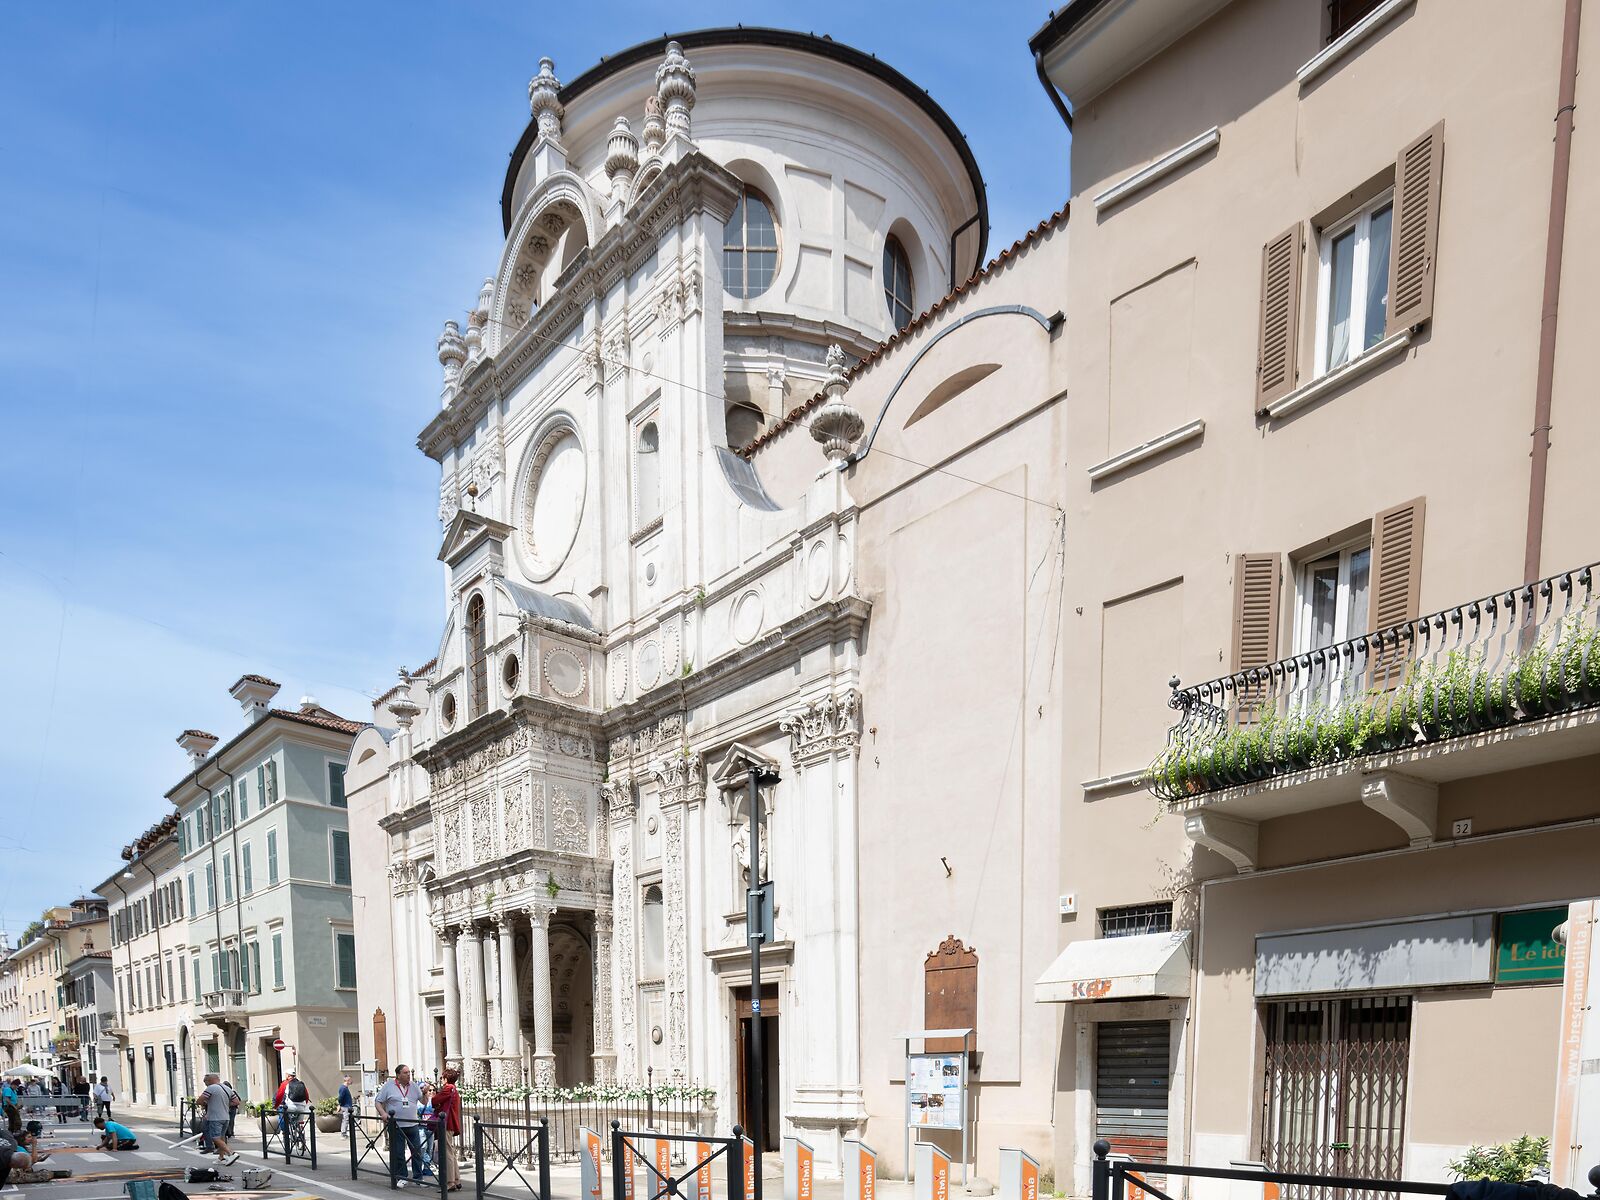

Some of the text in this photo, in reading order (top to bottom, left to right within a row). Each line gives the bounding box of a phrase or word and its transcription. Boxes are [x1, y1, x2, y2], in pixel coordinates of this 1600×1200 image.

[1511, 943, 1537, 961] Le
[1566, 913, 1588, 1087] www.bresciamobilita.it
[801, 1159, 810, 1197] bicimia
